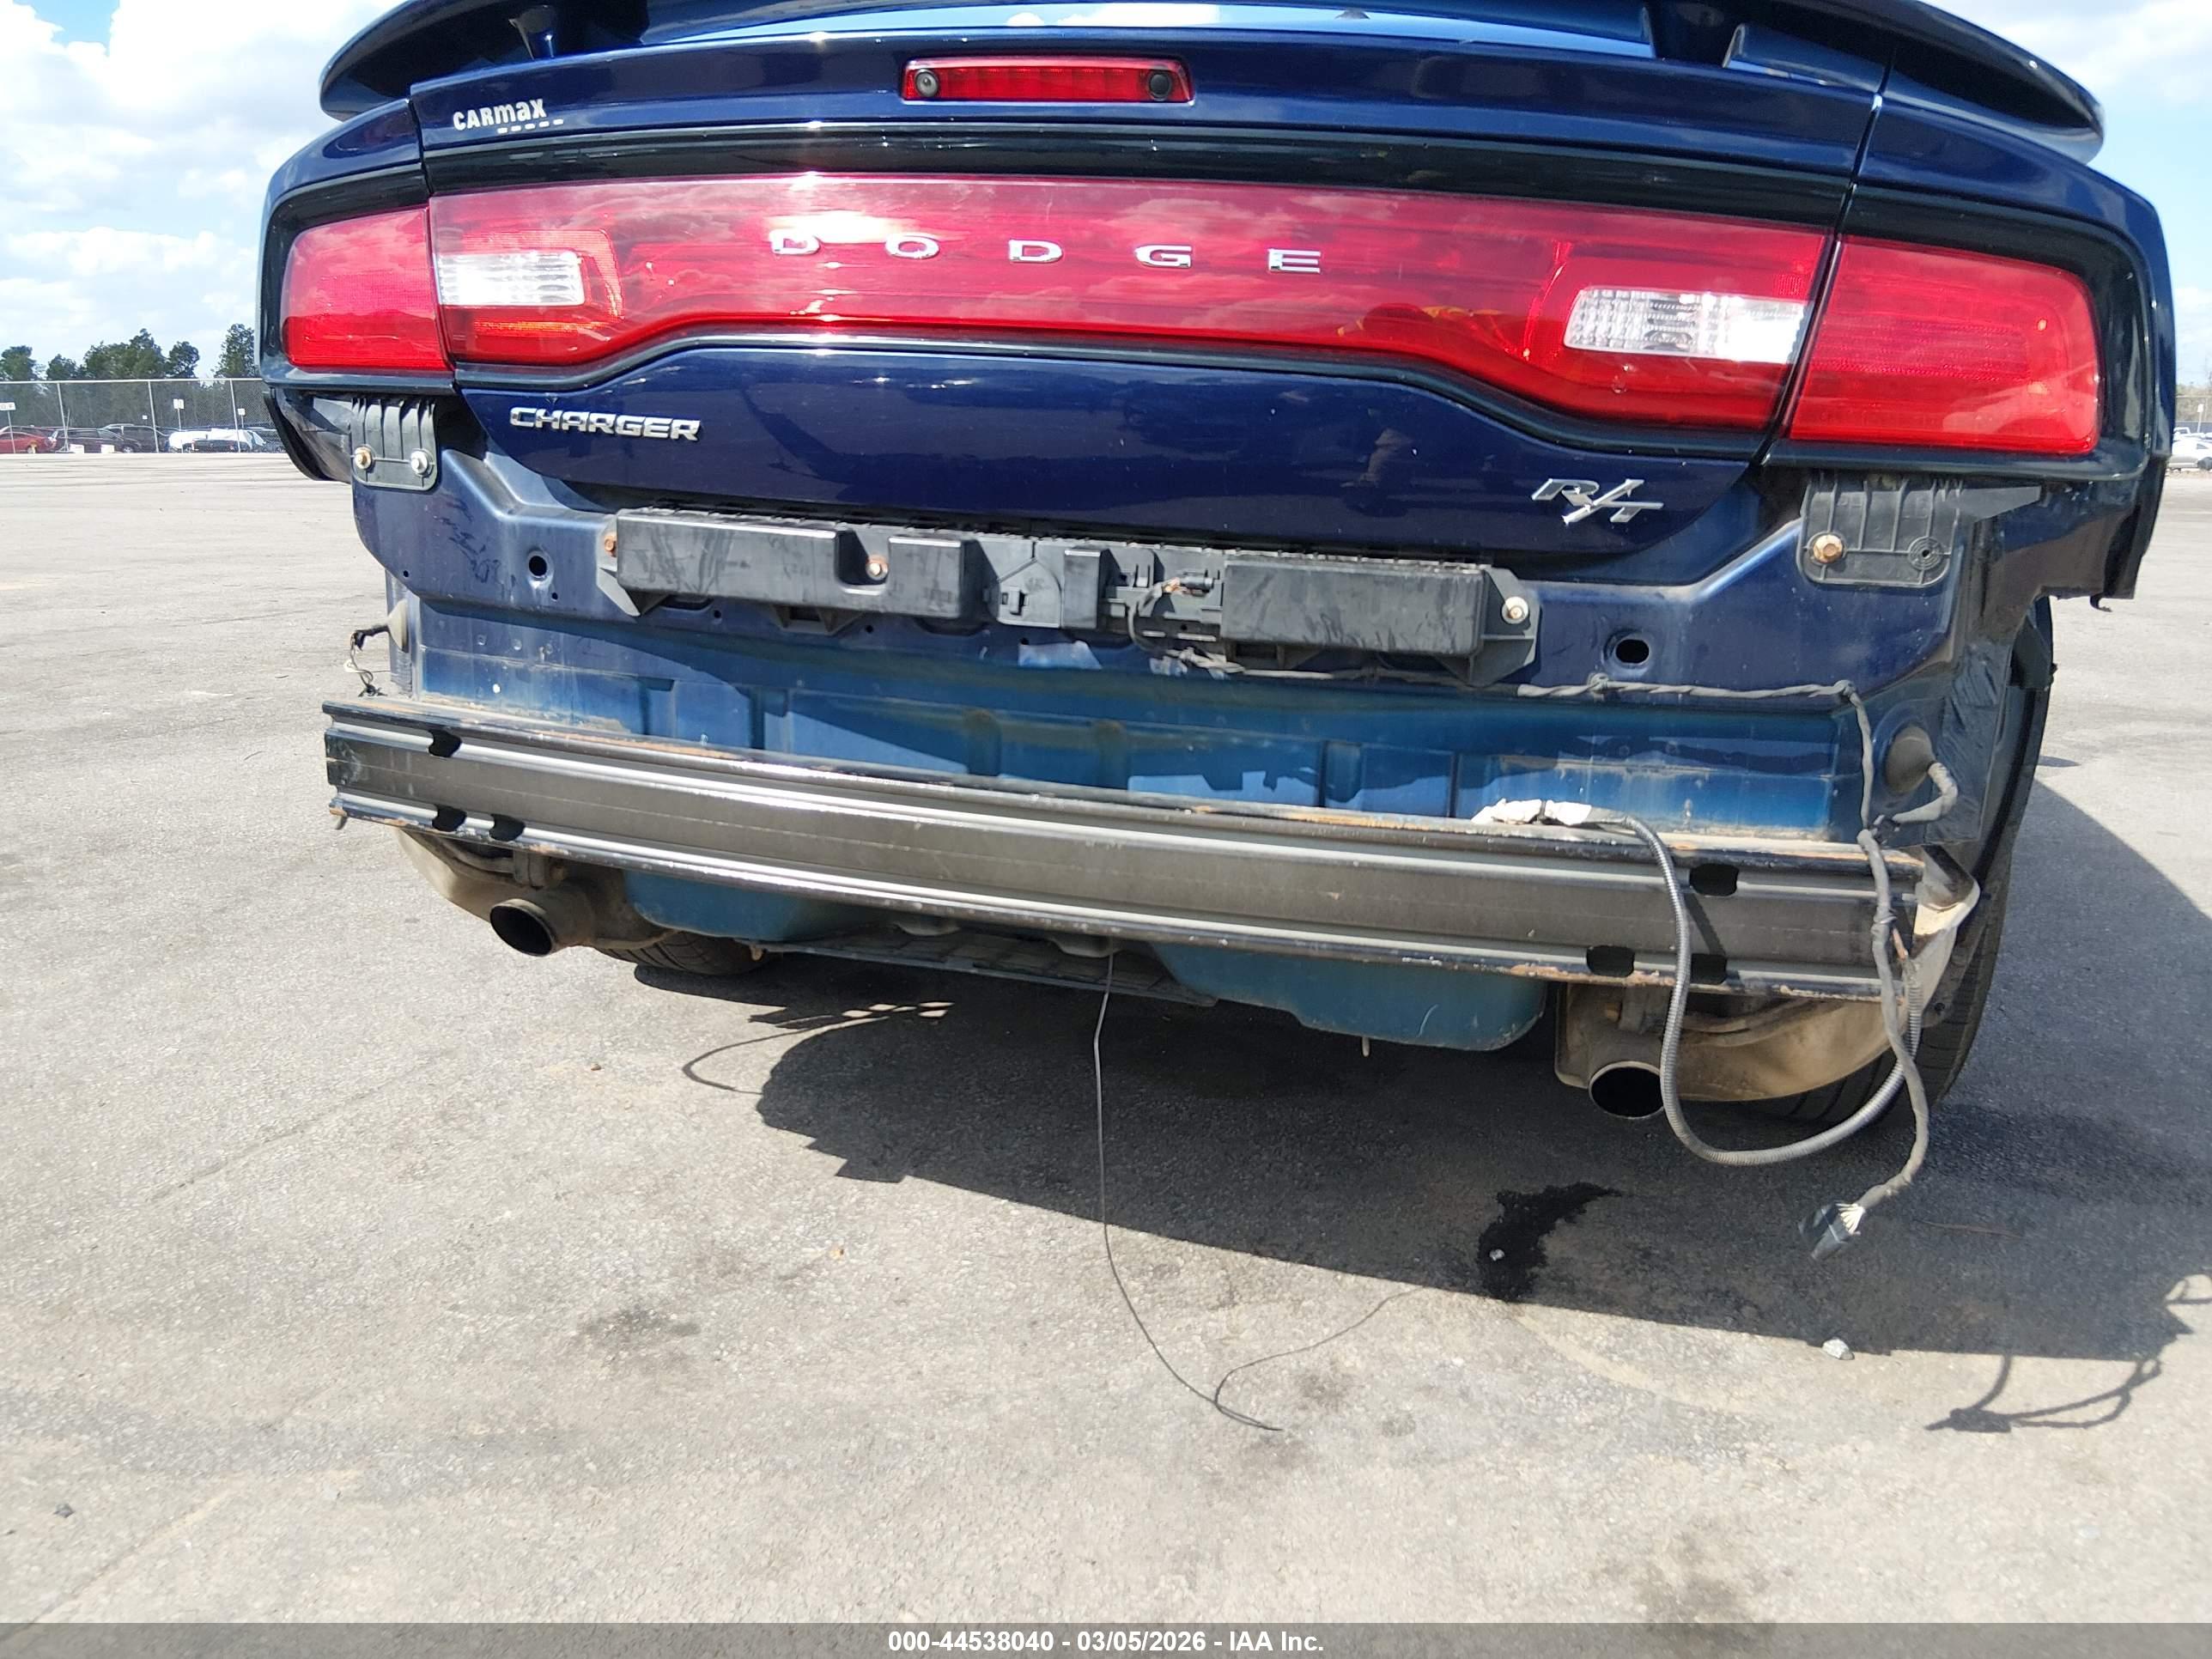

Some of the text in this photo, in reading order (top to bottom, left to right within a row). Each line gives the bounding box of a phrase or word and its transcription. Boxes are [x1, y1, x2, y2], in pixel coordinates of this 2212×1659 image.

[770, 228, 1322, 273] DODGE
[509, 407, 702, 441] CHARGER
[1531, 477, 1665, 525] R/T
